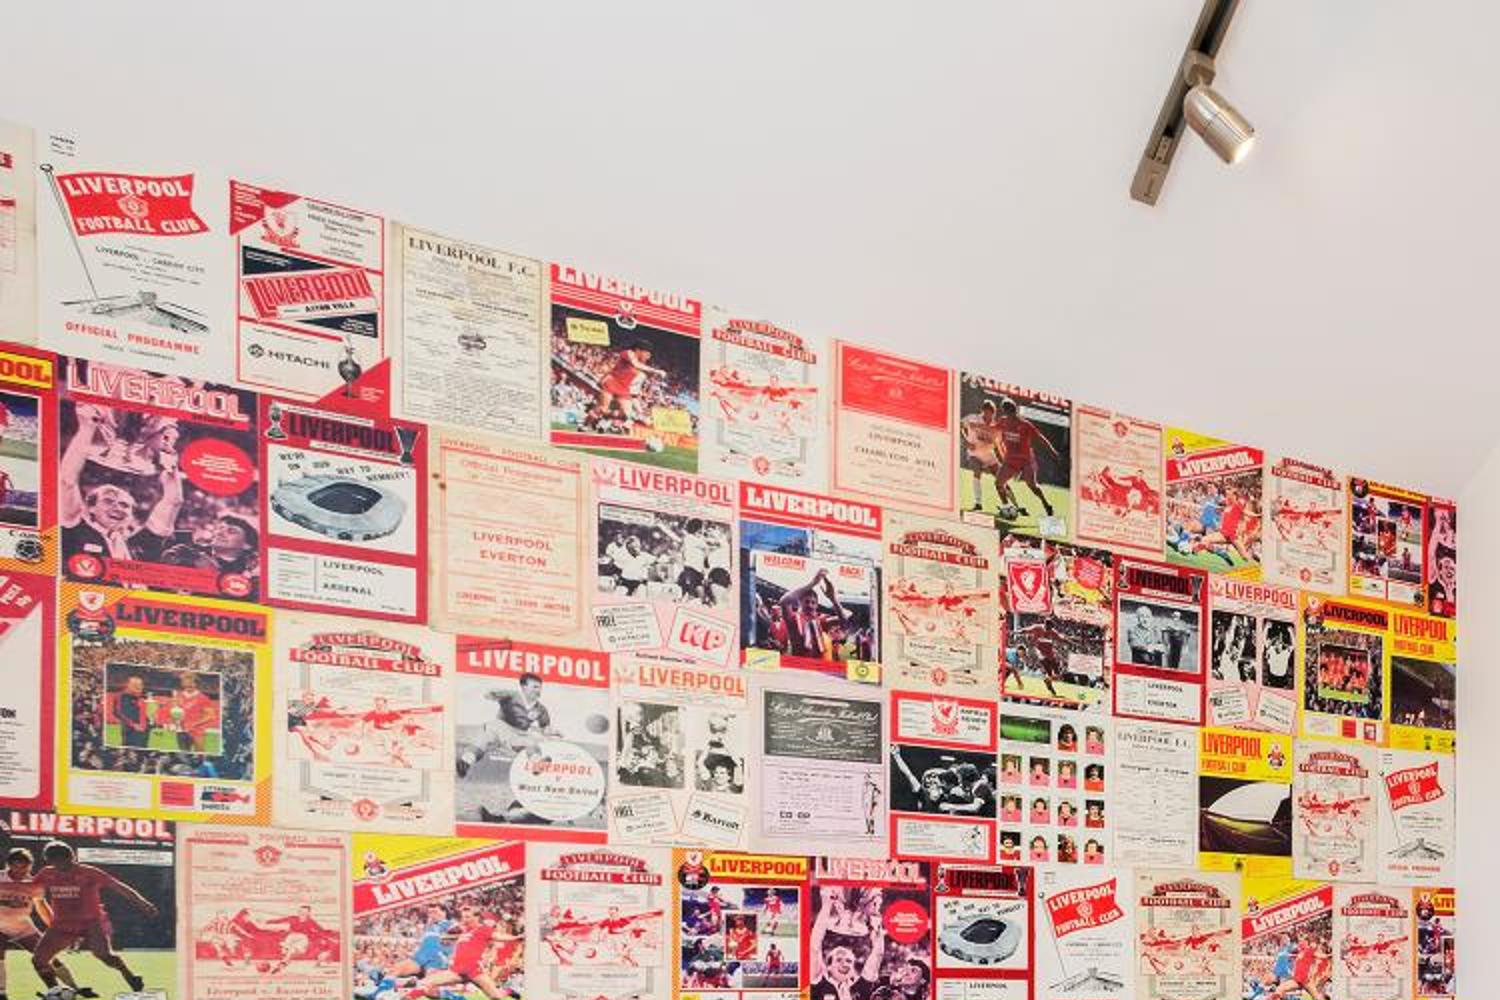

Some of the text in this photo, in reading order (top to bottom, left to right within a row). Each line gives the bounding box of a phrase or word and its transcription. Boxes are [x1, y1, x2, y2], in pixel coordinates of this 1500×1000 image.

[63, 178, 189, 198] LIVERPOOL
[77, 216, 199, 233] FOOTBALL CLUB
[409, 238, 502, 268] LIVERPOOL
[244, 270, 373, 320] LIVERPOOL
[559, 267, 695, 313] LIVERPOOL
[267, 349, 330, 369] HITACHI
[67, 363, 249, 421] LIVERPOOL
[288, 413, 394, 450] LIVERPOOL
[1176, 451, 1254, 475] LIVERPOOL
[619, 467, 733, 502] LIVERPOOL
[747, 485, 877, 527] LIVERPOOL
[473, 530, 553, 550] LIVERPOOL
[323, 560, 383, 576] LIVERPOOL
[479, 549, 547, 567] EVERTON
[1225, 584, 1296, 608] LIVERPOOL
[115, 604, 266, 637] LIVERPOOL
[1324, 606, 1388, 626] LIVERPOOL
[1393, 614, 1448, 641] LIVERPOOL
[317, 634, 415, 655] LIVERPOOL
[295, 651, 438, 675] FOOTBALL CLUB
[469, 651, 605, 681] LIVERPOOL
[639, 667, 745, 694] LIVERPOOL
[1203, 732, 1261, 759] LIVERPOOL
[10, 813, 172, 838] LIVERPOOL
[371, 854, 509, 905] LIVERPOOL
[709, 859, 806, 876] LIVERPOOL
[1049, 884, 1115, 911] LIVERPOOL
[1251, 897, 1324, 933] LIVERPOOL
